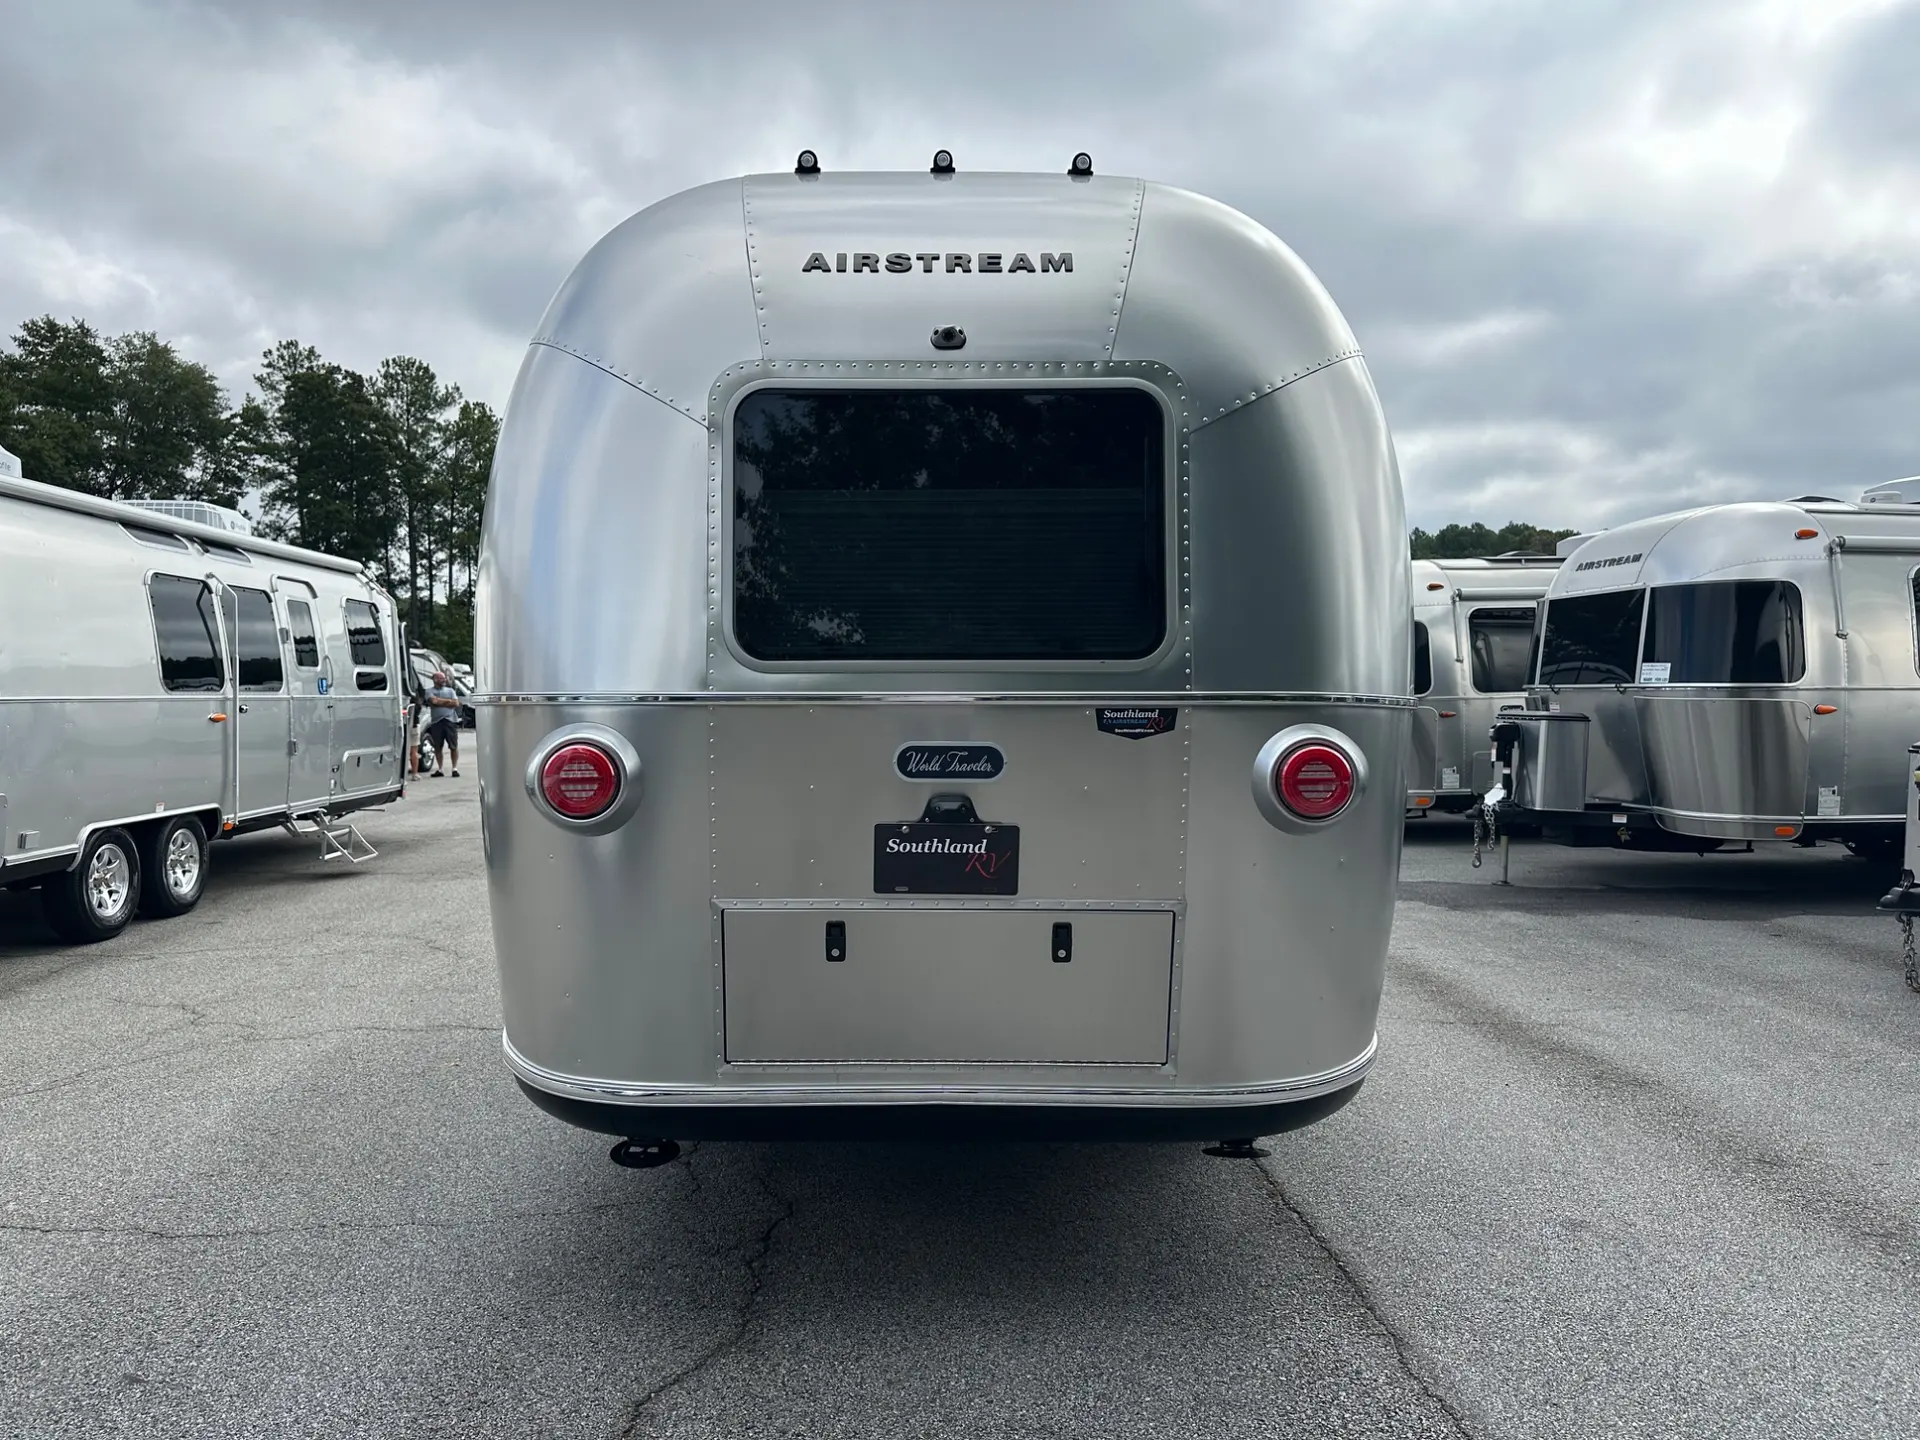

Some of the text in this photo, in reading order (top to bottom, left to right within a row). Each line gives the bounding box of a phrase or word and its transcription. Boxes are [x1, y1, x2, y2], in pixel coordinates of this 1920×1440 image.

[802, 252, 1074, 273] AIRSTREAM
[1575, 553, 1643, 572] AIRSTREAM
[1103, 709, 1159, 718] Southland
[906, 751, 993, 773] World Traveler
[886, 838, 988, 854] Southland
[965, 851, 1012, 878] RV
